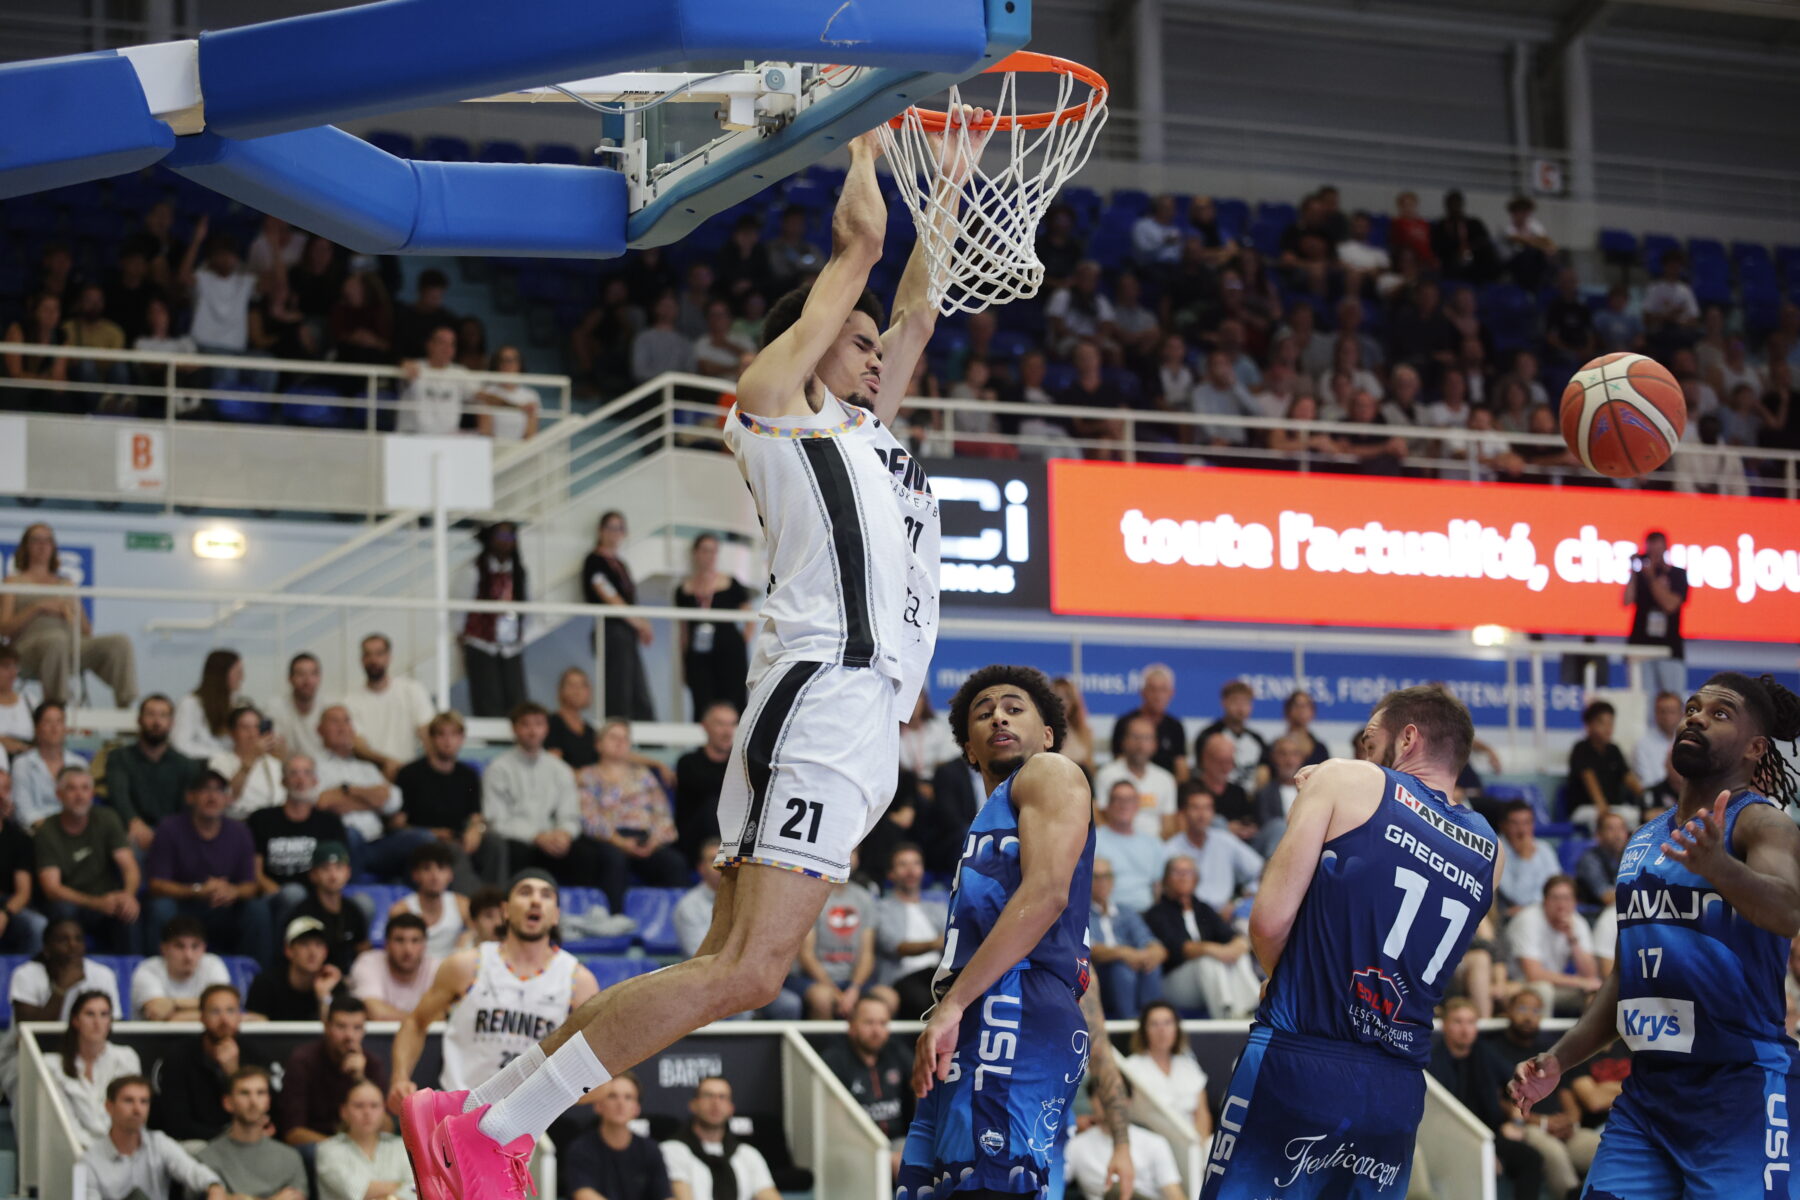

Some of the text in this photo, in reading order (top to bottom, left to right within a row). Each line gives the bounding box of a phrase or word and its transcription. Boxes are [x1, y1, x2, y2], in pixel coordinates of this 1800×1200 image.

[132, 432, 153, 470] B
[1119, 508, 1274, 570] toute
[1279, 509, 1550, 592] l'actualité,
[1554, 524, 1733, 590] chaue
[779, 797, 824, 843] 21
[1396, 785, 1495, 860] MAYENNE
[1384, 823, 1484, 902] GREGOIRE
[1637, 947, 1663, 979] 17
[974, 994, 1021, 1091] USL
[1623, 1009, 1682, 1043] Krys
[1205, 1095, 1250, 1187] USL
[1273, 1134, 1402, 1193] Festiconcept
[1763, 1092, 1791, 1192] USL
